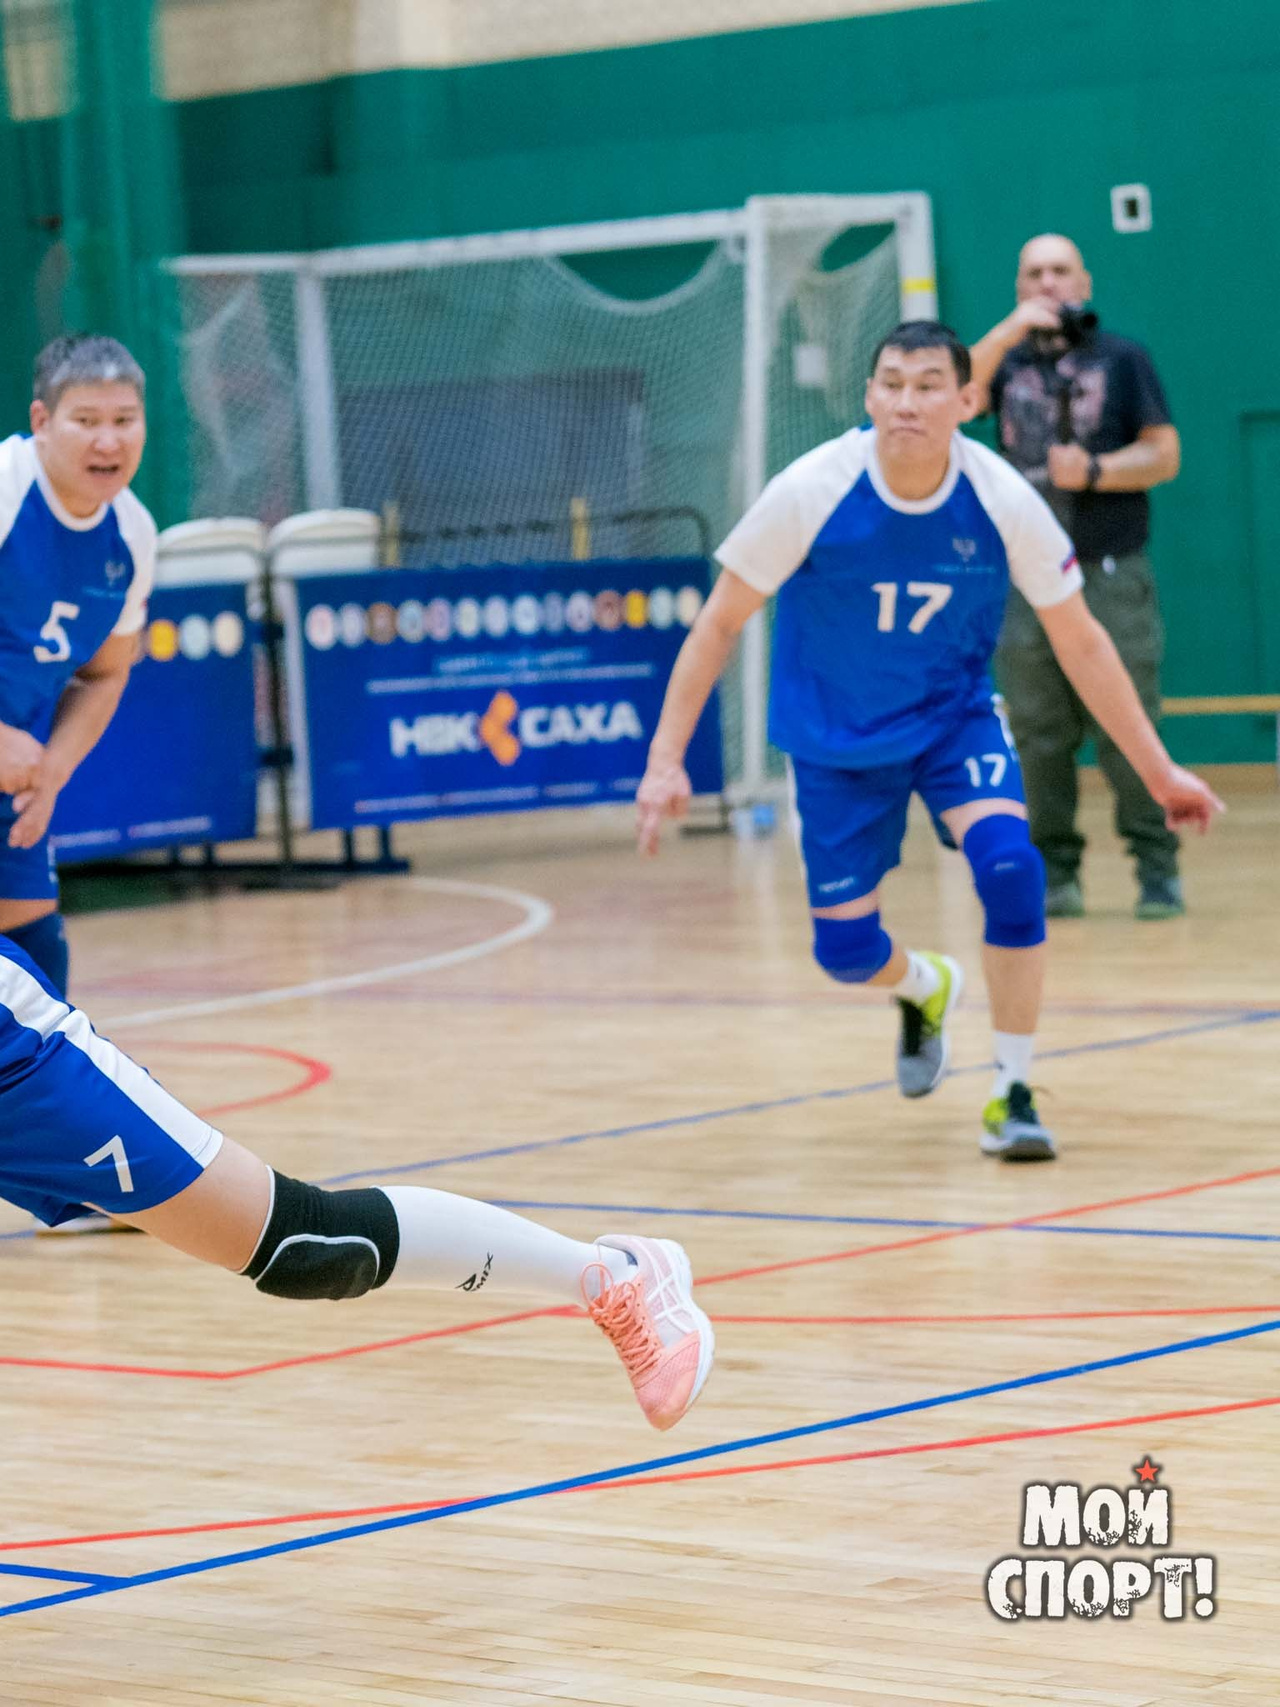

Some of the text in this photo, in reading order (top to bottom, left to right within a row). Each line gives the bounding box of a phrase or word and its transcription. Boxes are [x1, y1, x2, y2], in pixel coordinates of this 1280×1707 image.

[34, 601, 80, 663] 5
[871, 581, 953, 634] 17
[519, 701, 643, 748] САХА
[965, 753, 1007, 787] 17
[83, 1134, 134, 1193] 7
